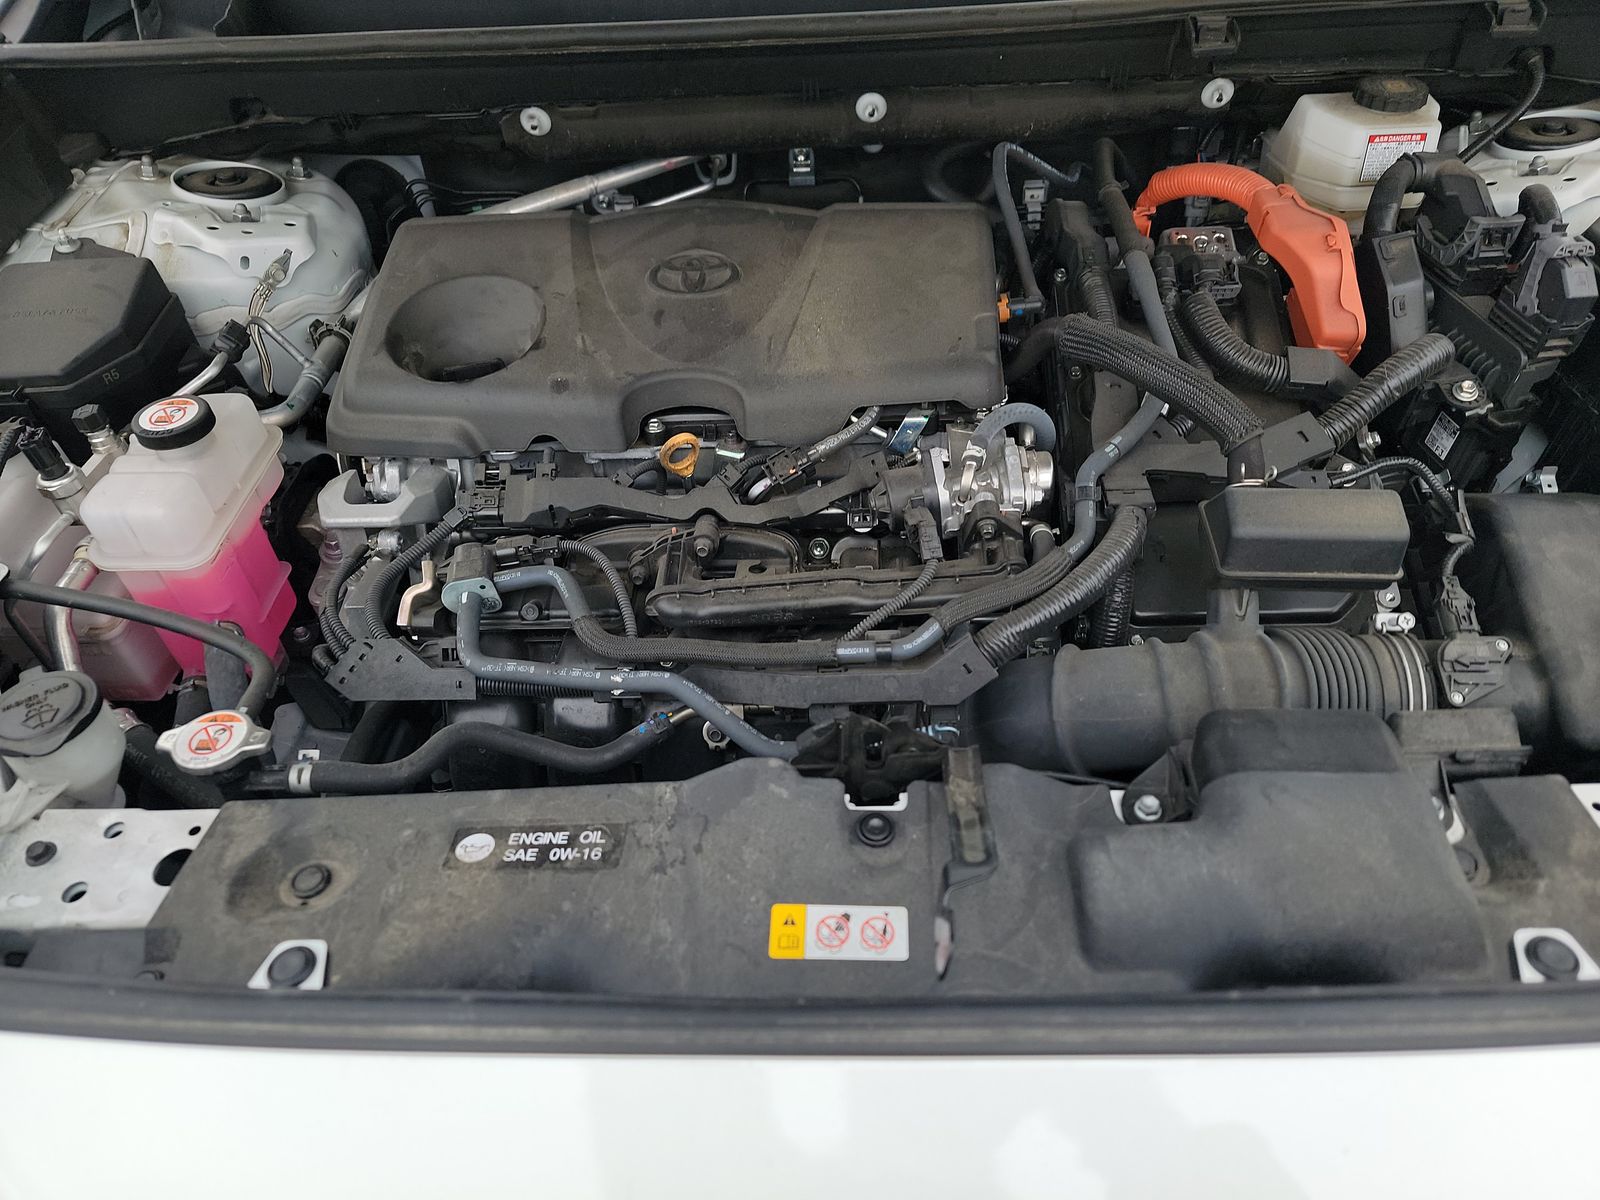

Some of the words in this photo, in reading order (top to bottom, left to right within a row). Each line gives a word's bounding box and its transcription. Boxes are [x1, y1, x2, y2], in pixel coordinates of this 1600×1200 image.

[1388, 134, 1411, 142] DANGER
[102, 368, 120, 385] R5
[44, 682, 69, 696] FLUID
[508, 832, 569, 845] ENGINE
[579, 830, 606, 844] OIL
[503, 848, 539, 862] SAE
[549, 847, 603, 862] 0W-16
